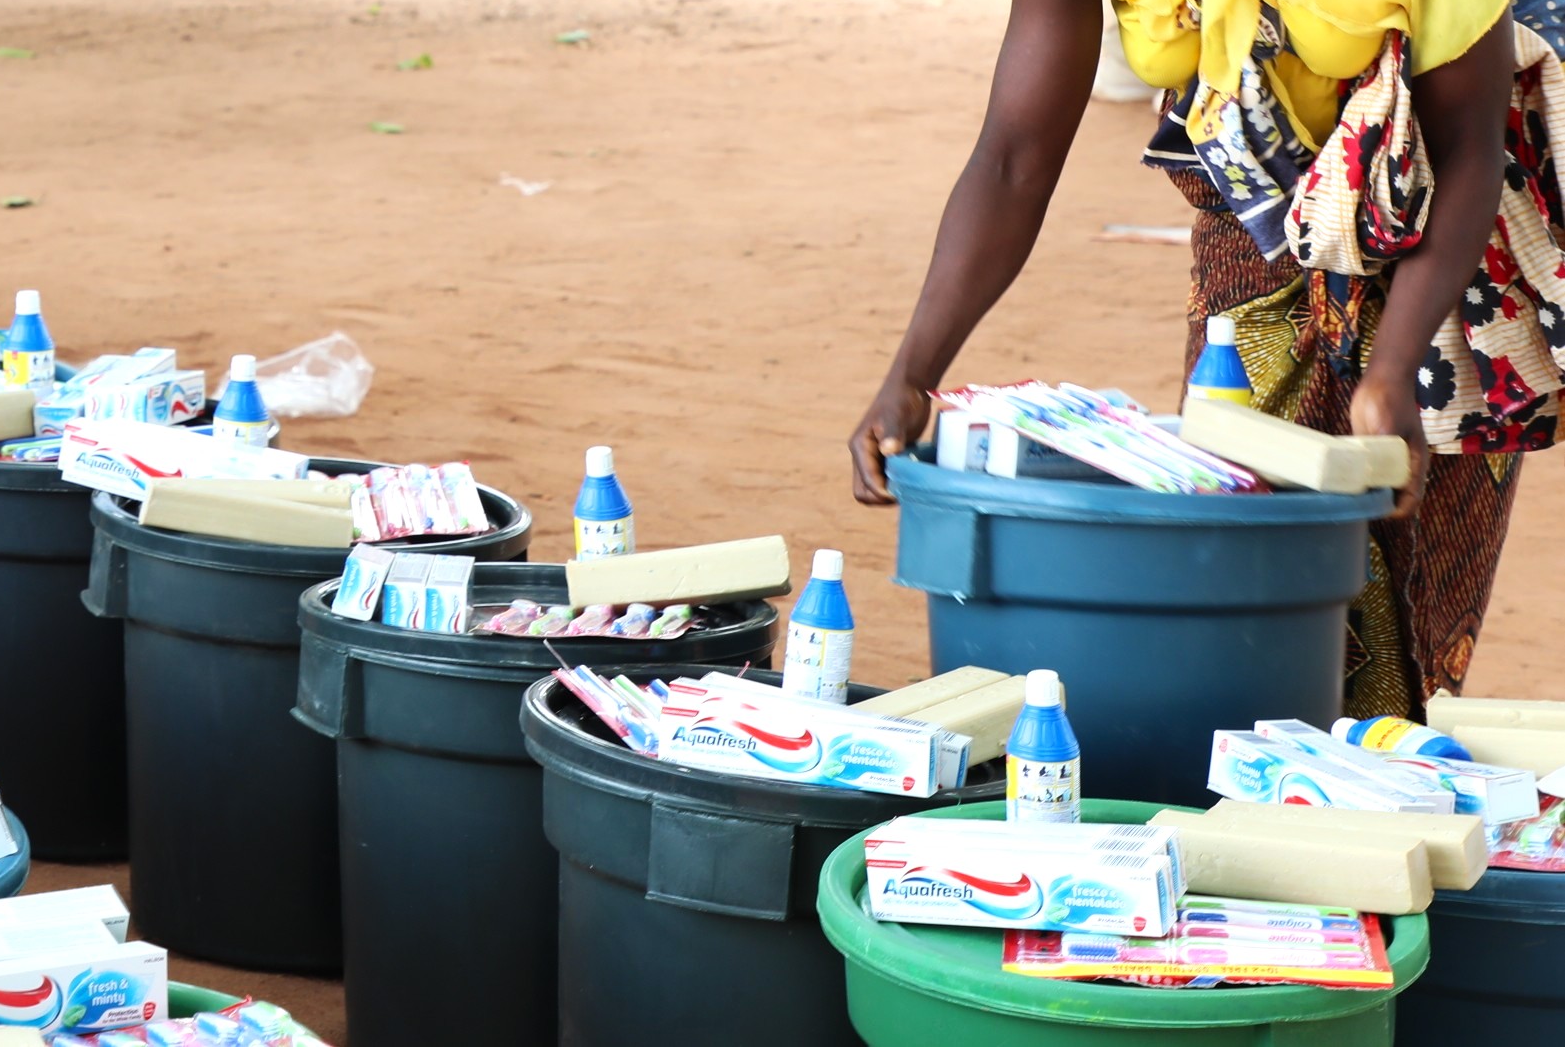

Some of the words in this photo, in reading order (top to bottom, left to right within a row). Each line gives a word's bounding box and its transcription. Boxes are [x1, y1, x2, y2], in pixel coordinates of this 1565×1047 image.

[75, 452, 140, 479] Aquafresh
[672, 726, 757, 751] Aquafresh
[850, 743, 884, 757] fresco
[840, 754, 900, 769] mentolado
[883, 878, 973, 899] Aquafresh
[1072, 885, 1107, 898] fresco
[1064, 897, 1125, 909] mentolado
[1267, 918, 1312, 930] Colgate
[1268, 933, 1315, 944] Colgate
[88, 980, 117, 997] fresh
[120, 977, 129, 989] &
[92, 992, 126, 1007] minty
